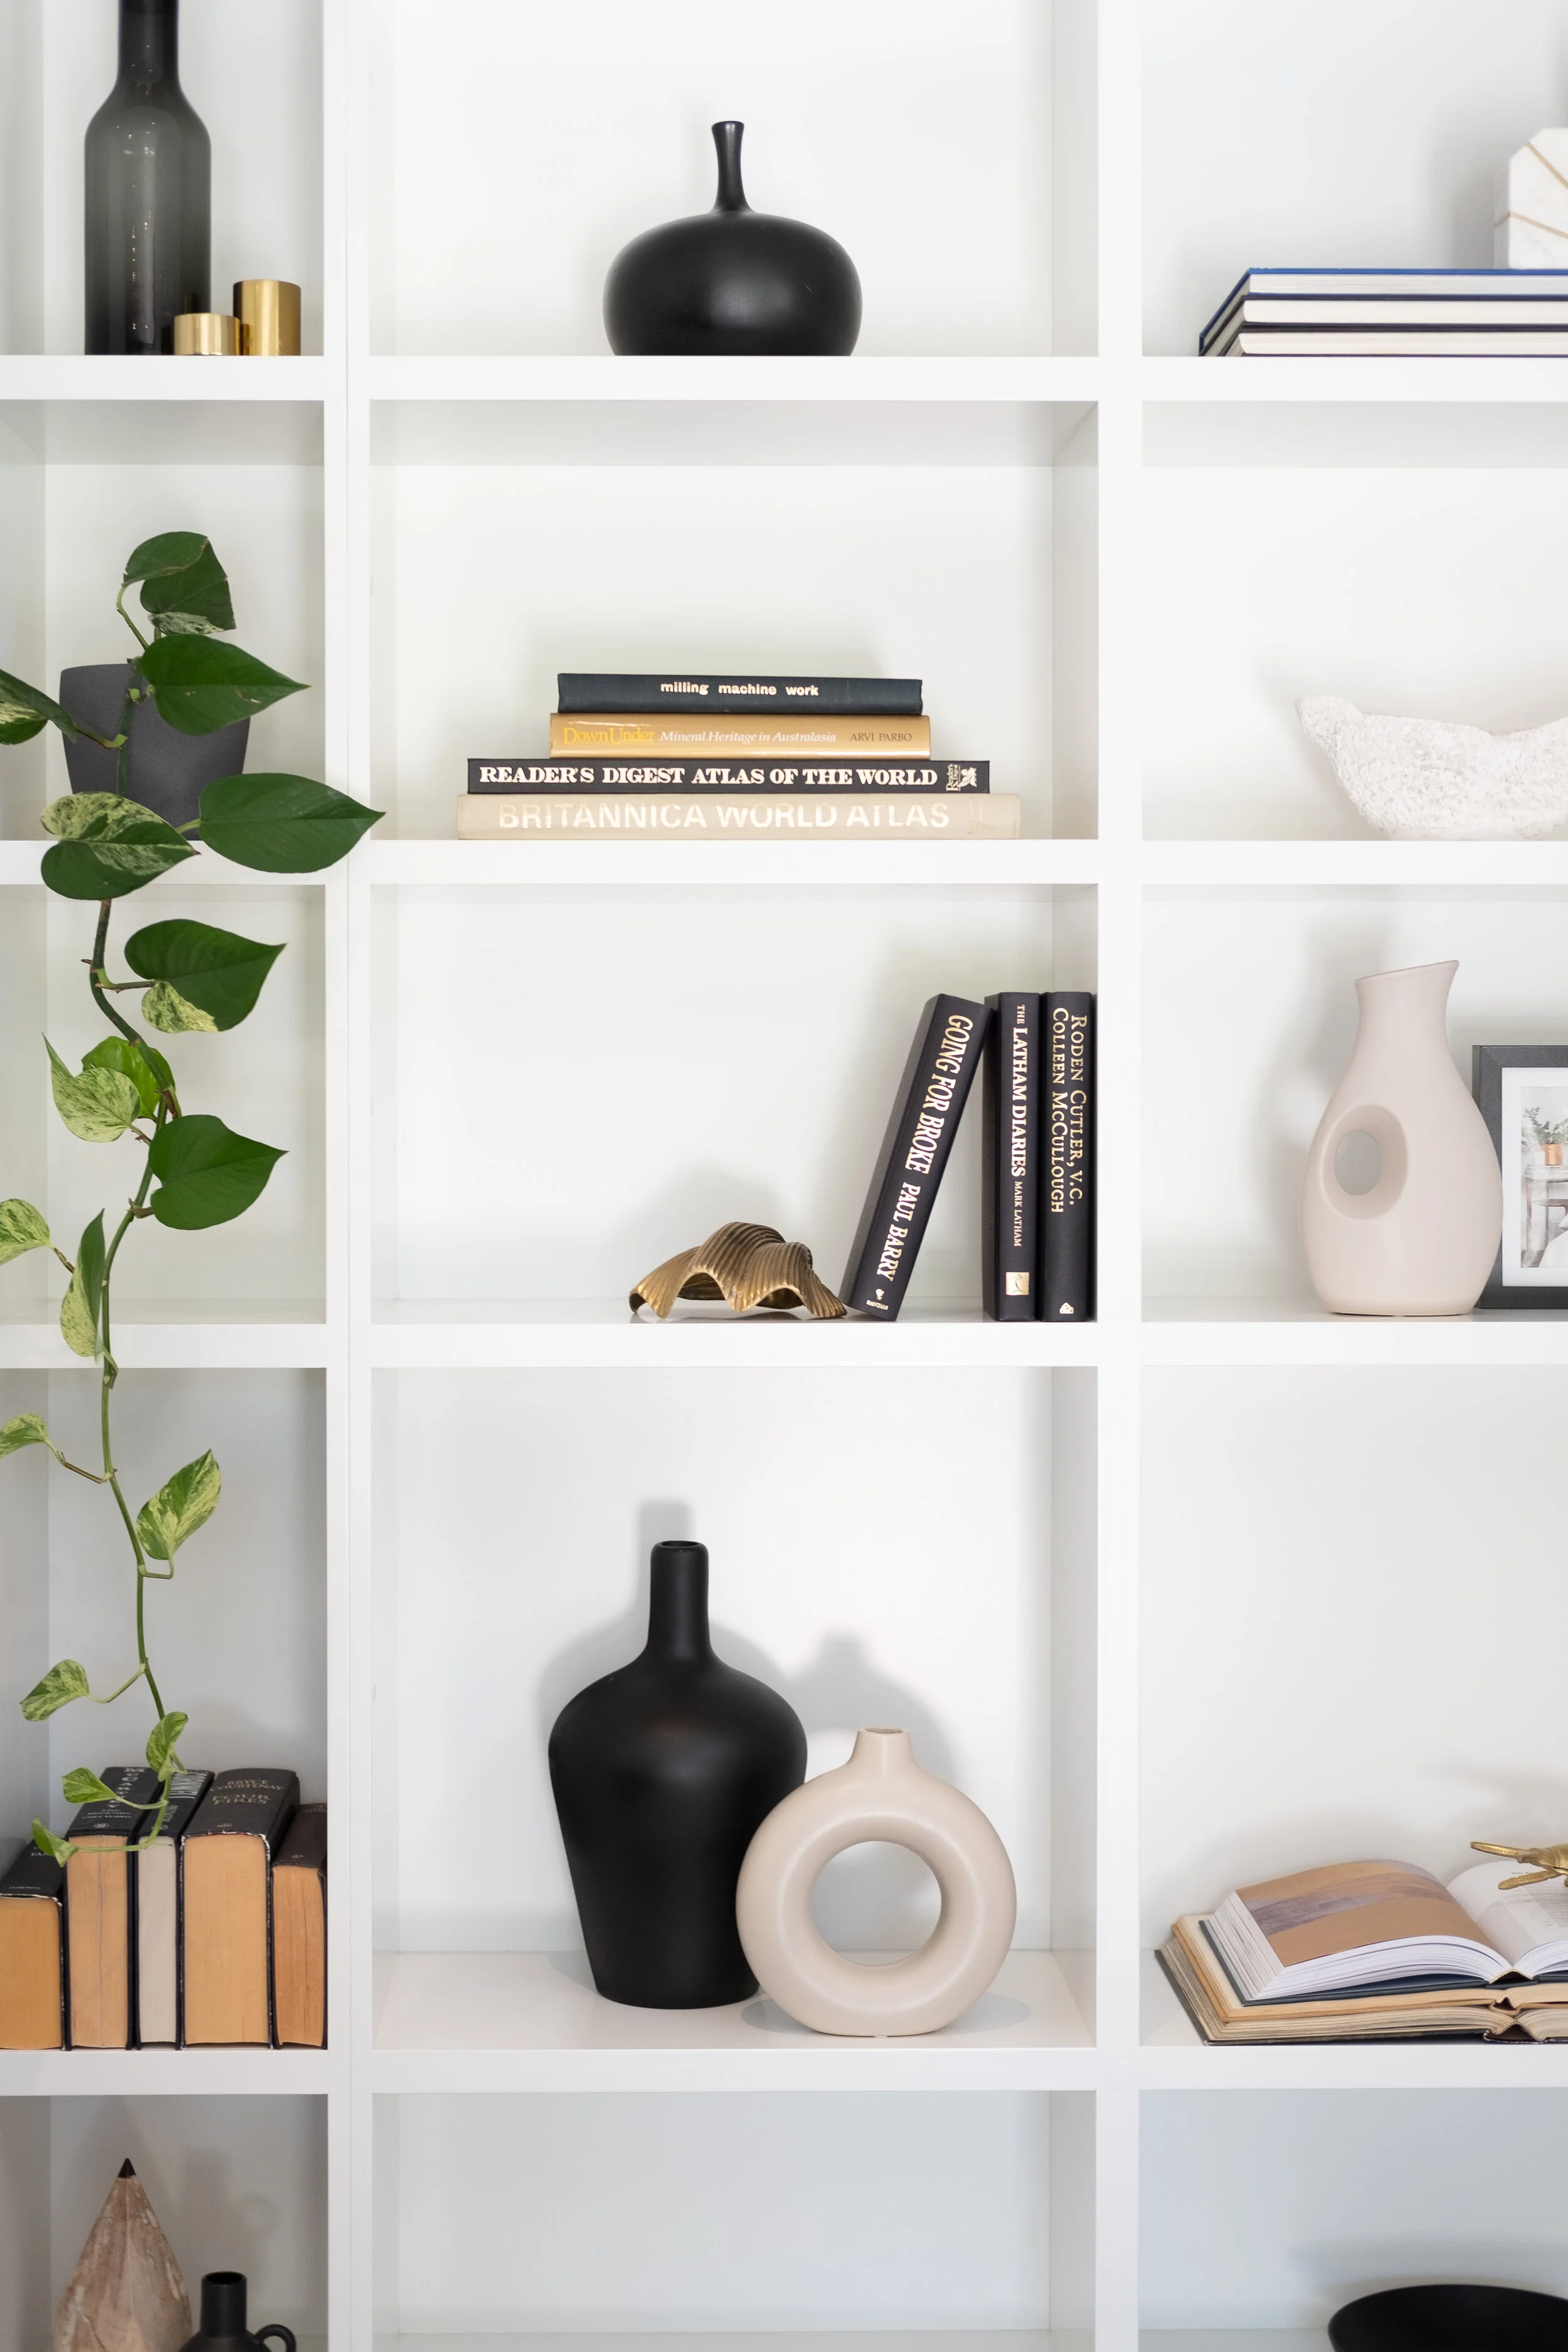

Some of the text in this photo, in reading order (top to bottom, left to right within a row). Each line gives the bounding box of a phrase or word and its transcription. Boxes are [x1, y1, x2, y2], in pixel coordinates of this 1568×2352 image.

[660, 681, 819, 696] milling machine work
[660, 731, 836, 744] Mineral Heritage in Australasia
[850, 733, 912, 742] ARVI PARBO
[479, 766, 938, 785] READER'S DIGEST ATLAS OF THE WORLD
[499, 803, 707, 829] BRITANNICA
[716, 803, 838, 829] WORLD
[845, 803, 950, 829] ATLAS
[1052, 1007, 1069, 1084] COLLEEN
[1070, 1014, 1088, 1081] RODEN
[904, 1015, 973, 1174] GOING FOR BROKE
[1010, 1004, 1028, 1177] THE LATHAM DIARIES
[893, 1182, 921, 1222] PAUL
[1014, 1181, 1023, 1247] MARK LATHAM
[876, 1224, 908, 1281] BARRY
